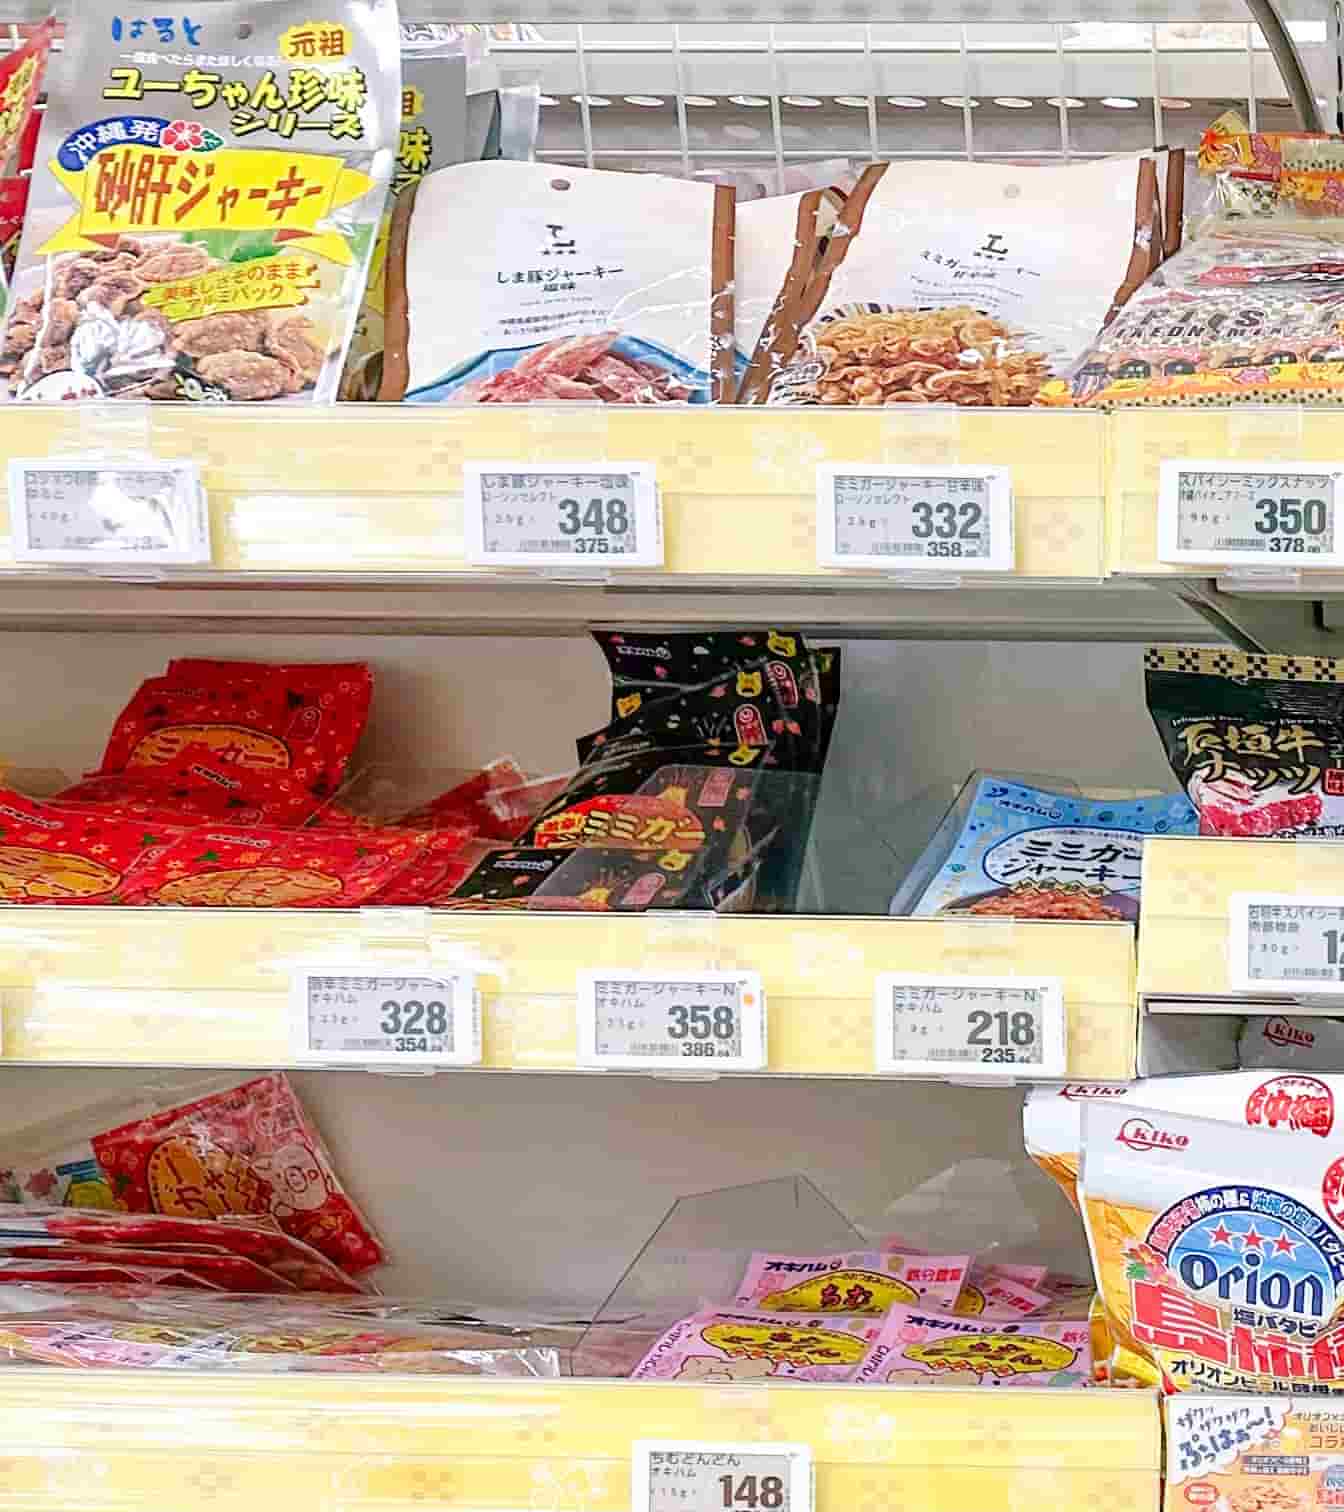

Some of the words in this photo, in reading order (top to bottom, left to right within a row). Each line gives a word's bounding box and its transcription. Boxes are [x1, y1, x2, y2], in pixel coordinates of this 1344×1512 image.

[111, 15, 203, 46] はると
[288, 27, 346, 58] 元祖
[103, 66, 368, 113] ユーちゃん珍味
[67, 117, 162, 168] 沖縄発
[229, 110, 365, 141] シリーズ
[93, 147, 324, 227] 砂肝ジャーキー
[557, 498, 628, 535] 348
[911, 502, 982, 540] 332
[1255, 497, 1327, 535] 350
[1199, 752, 1320, 793] ナッツ
[379, 1001, 447, 1035] 328
[667, 1004, 735, 1040] 358
[966, 1009, 1035, 1046] 218
[649, 1451, 741, 1467] ちむどんどん
[718, 1475, 784, 1509] 148
